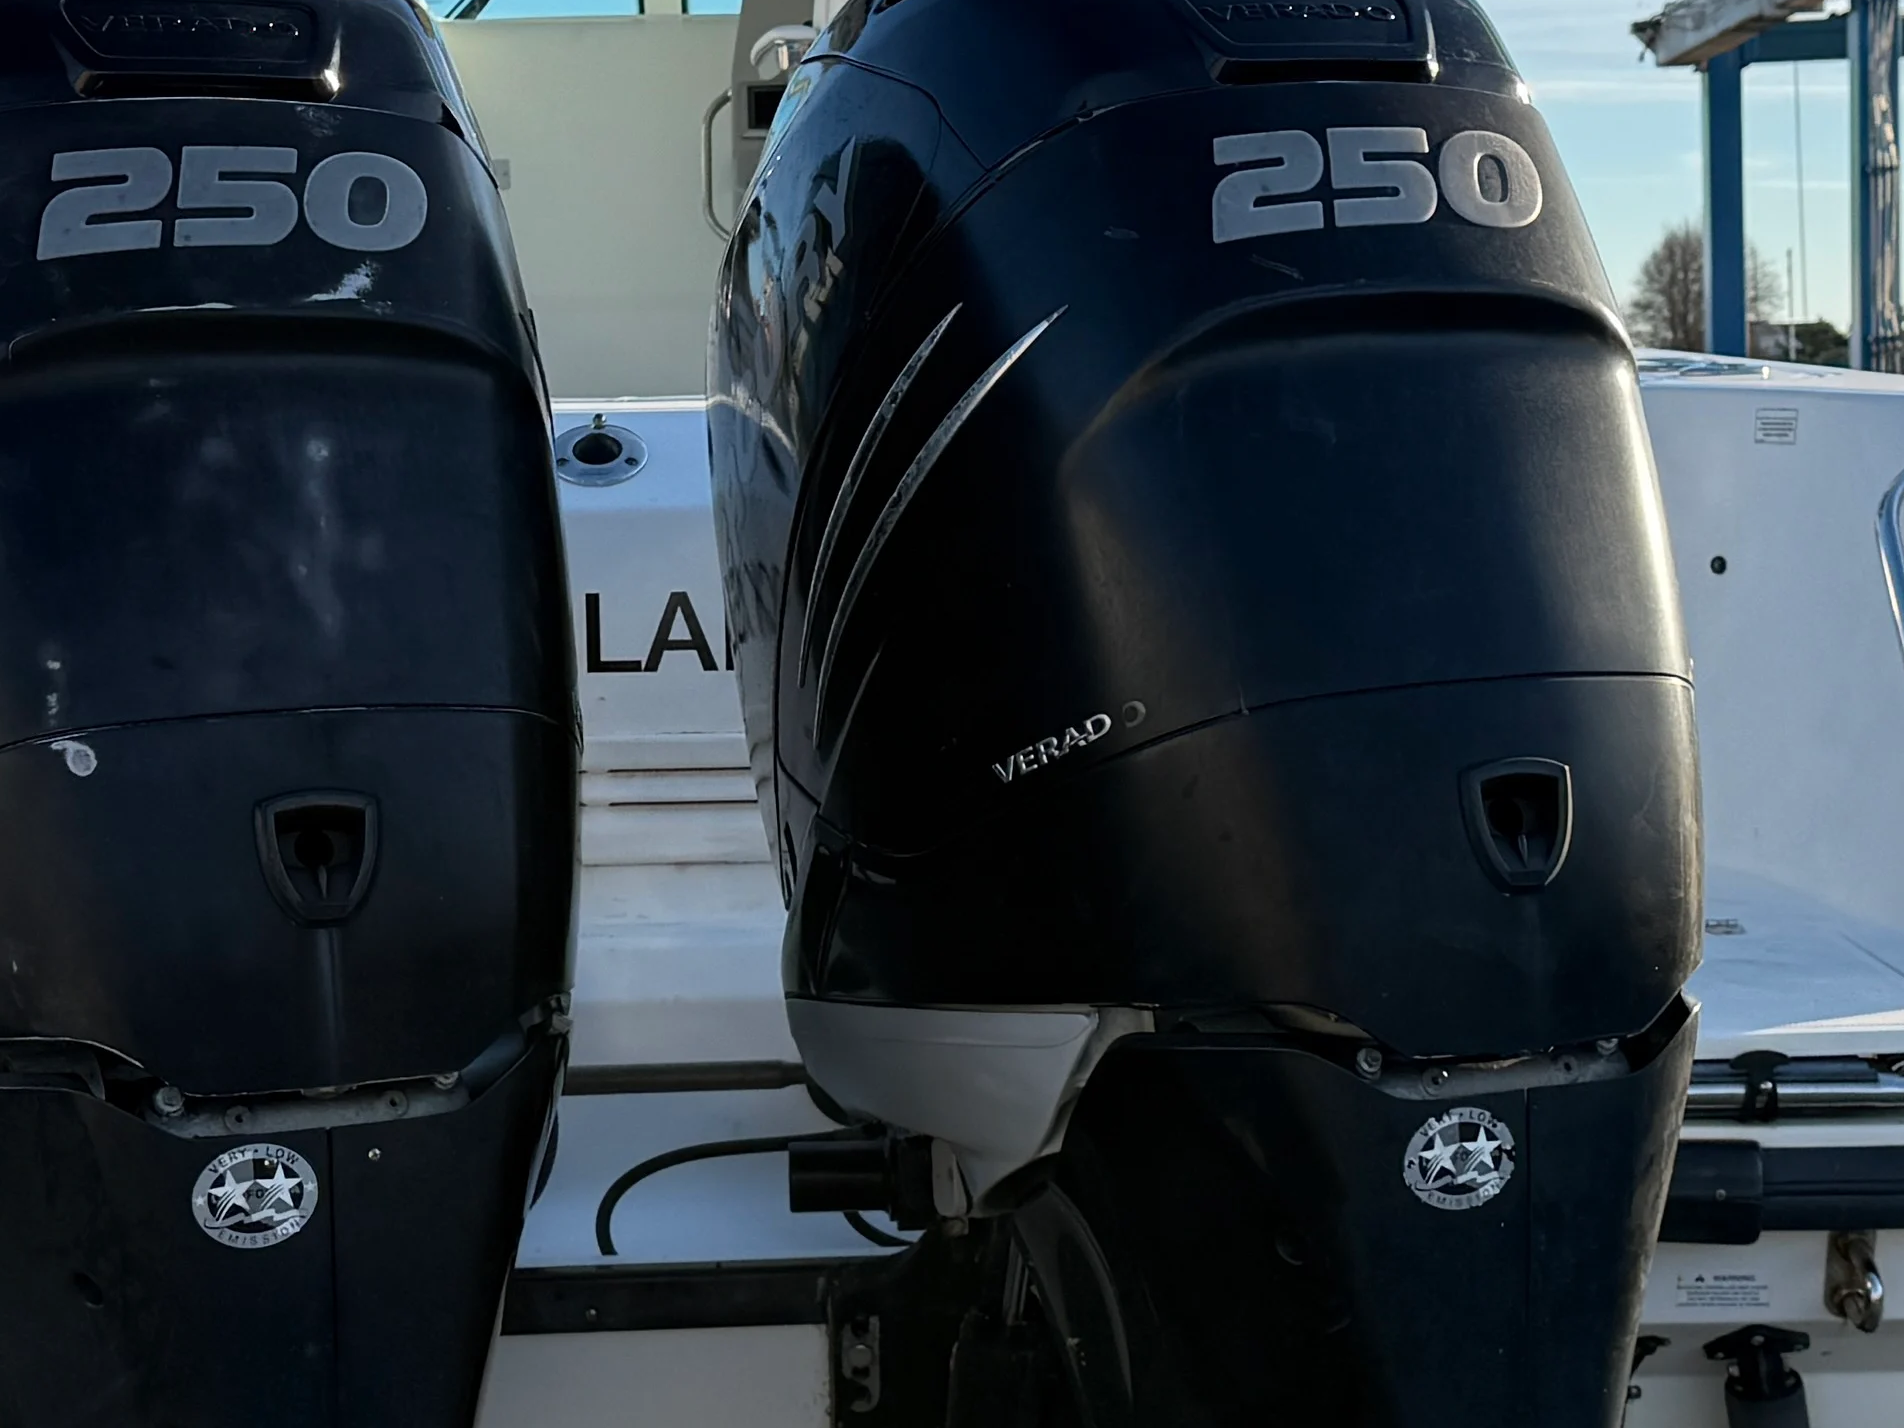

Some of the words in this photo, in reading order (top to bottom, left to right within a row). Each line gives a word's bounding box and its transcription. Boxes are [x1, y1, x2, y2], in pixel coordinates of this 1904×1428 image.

[37, 145, 428, 260] 250
[1212, 127, 1542, 243] 250
[992, 700, 1146, 784] VERADO
[208, 1147, 247, 1174] VERY
[265, 1146, 300, 1165] LOW
[217, 1218, 302, 1245] EMISSION
